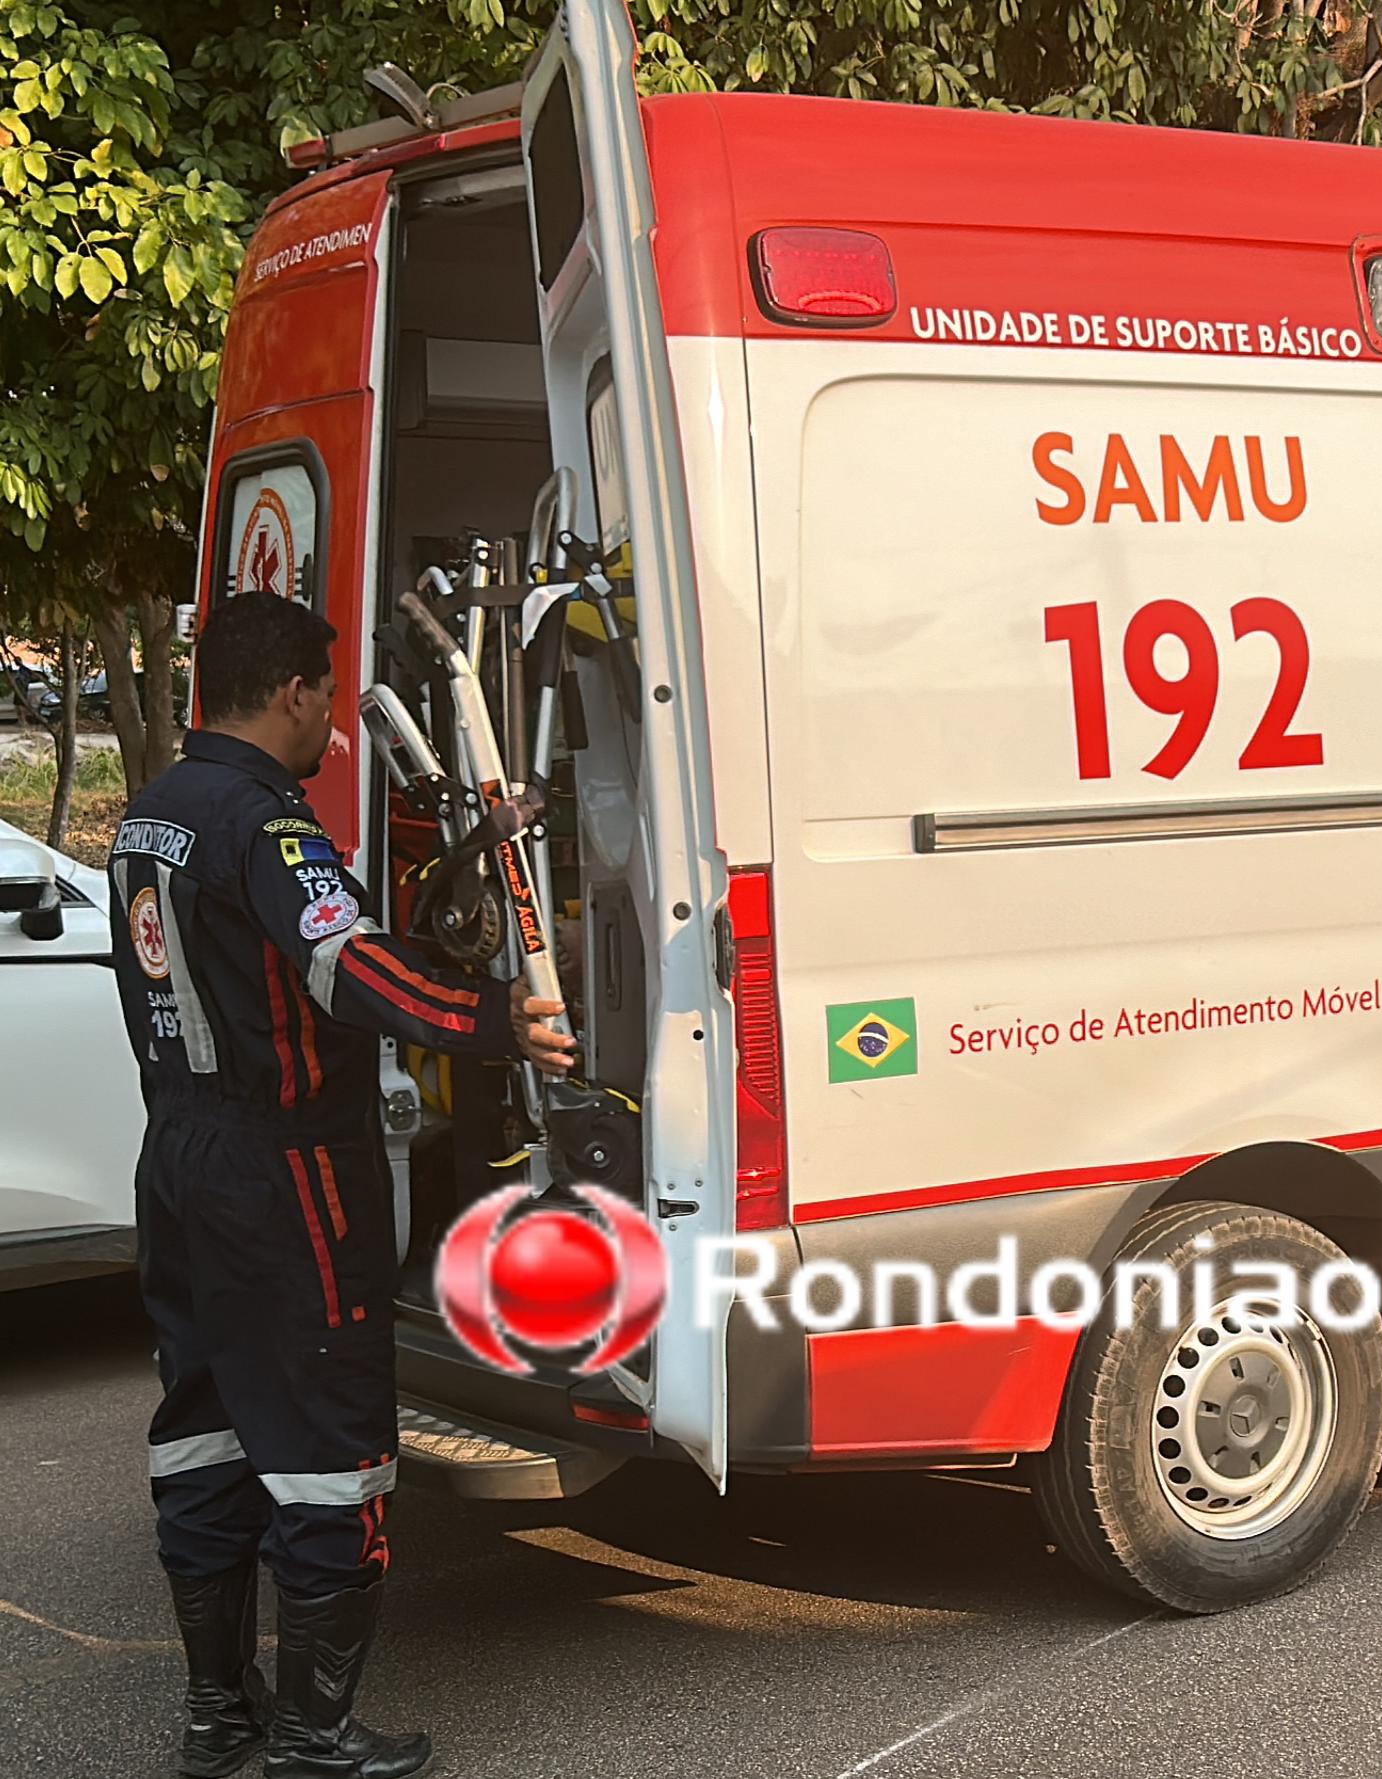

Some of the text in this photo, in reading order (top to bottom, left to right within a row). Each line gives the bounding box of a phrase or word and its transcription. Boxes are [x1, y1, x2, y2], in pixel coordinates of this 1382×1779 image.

[254, 222, 373, 282] SERVIÇO DE ATENDIMEN
[910, 306, 1364, 358] UNIDADE DE SUPORTE BÁSICO
[1031, 431, 1308, 526] SAMU
[1044, 597, 1324, 780] 192
[295, 866, 341, 882] SAMU
[302, 879, 348, 902] 192
[515, 905, 542, 952] AGILA
[147, 991, 177, 1008] SAM
[949, 1018, 1061, 1056] Serviço
[1068, 1009, 1105, 1043] de
[1113, 998, 1294, 1037] Atendimento
[1302, 980, 1381, 1018] Móvel
